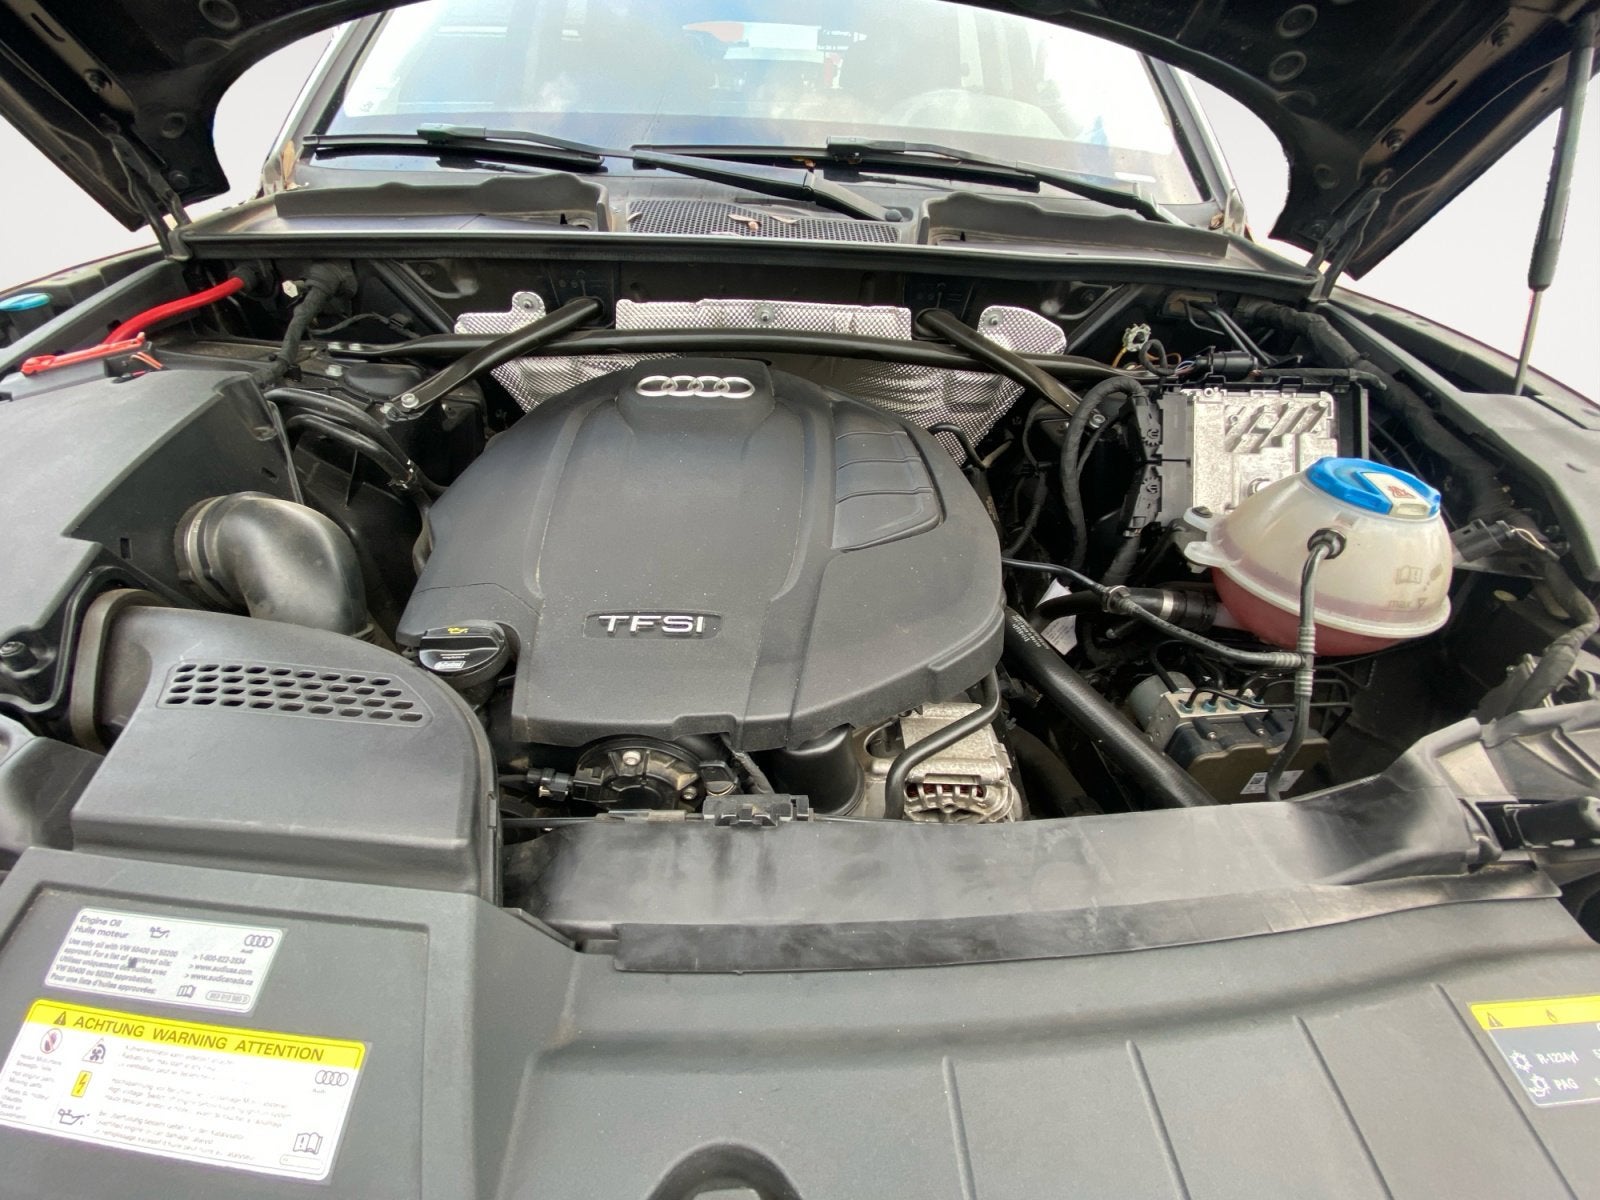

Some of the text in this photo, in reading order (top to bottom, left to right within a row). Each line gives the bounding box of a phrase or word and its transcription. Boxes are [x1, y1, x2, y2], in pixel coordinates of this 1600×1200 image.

[598, 614, 705, 636] TFSI
[80, 915, 122, 926] Engine Oil
[75, 925, 129, 937] Huile moteur
[191, 973, 254, 985] www.audicanada.ca
[73, 1015, 145, 1038] ACHTUNG
[153, 1028, 228, 1050] WARNING
[234, 1039, 325, 1061] ATTENTION
[1552, 1077, 1580, 1090] PAG
